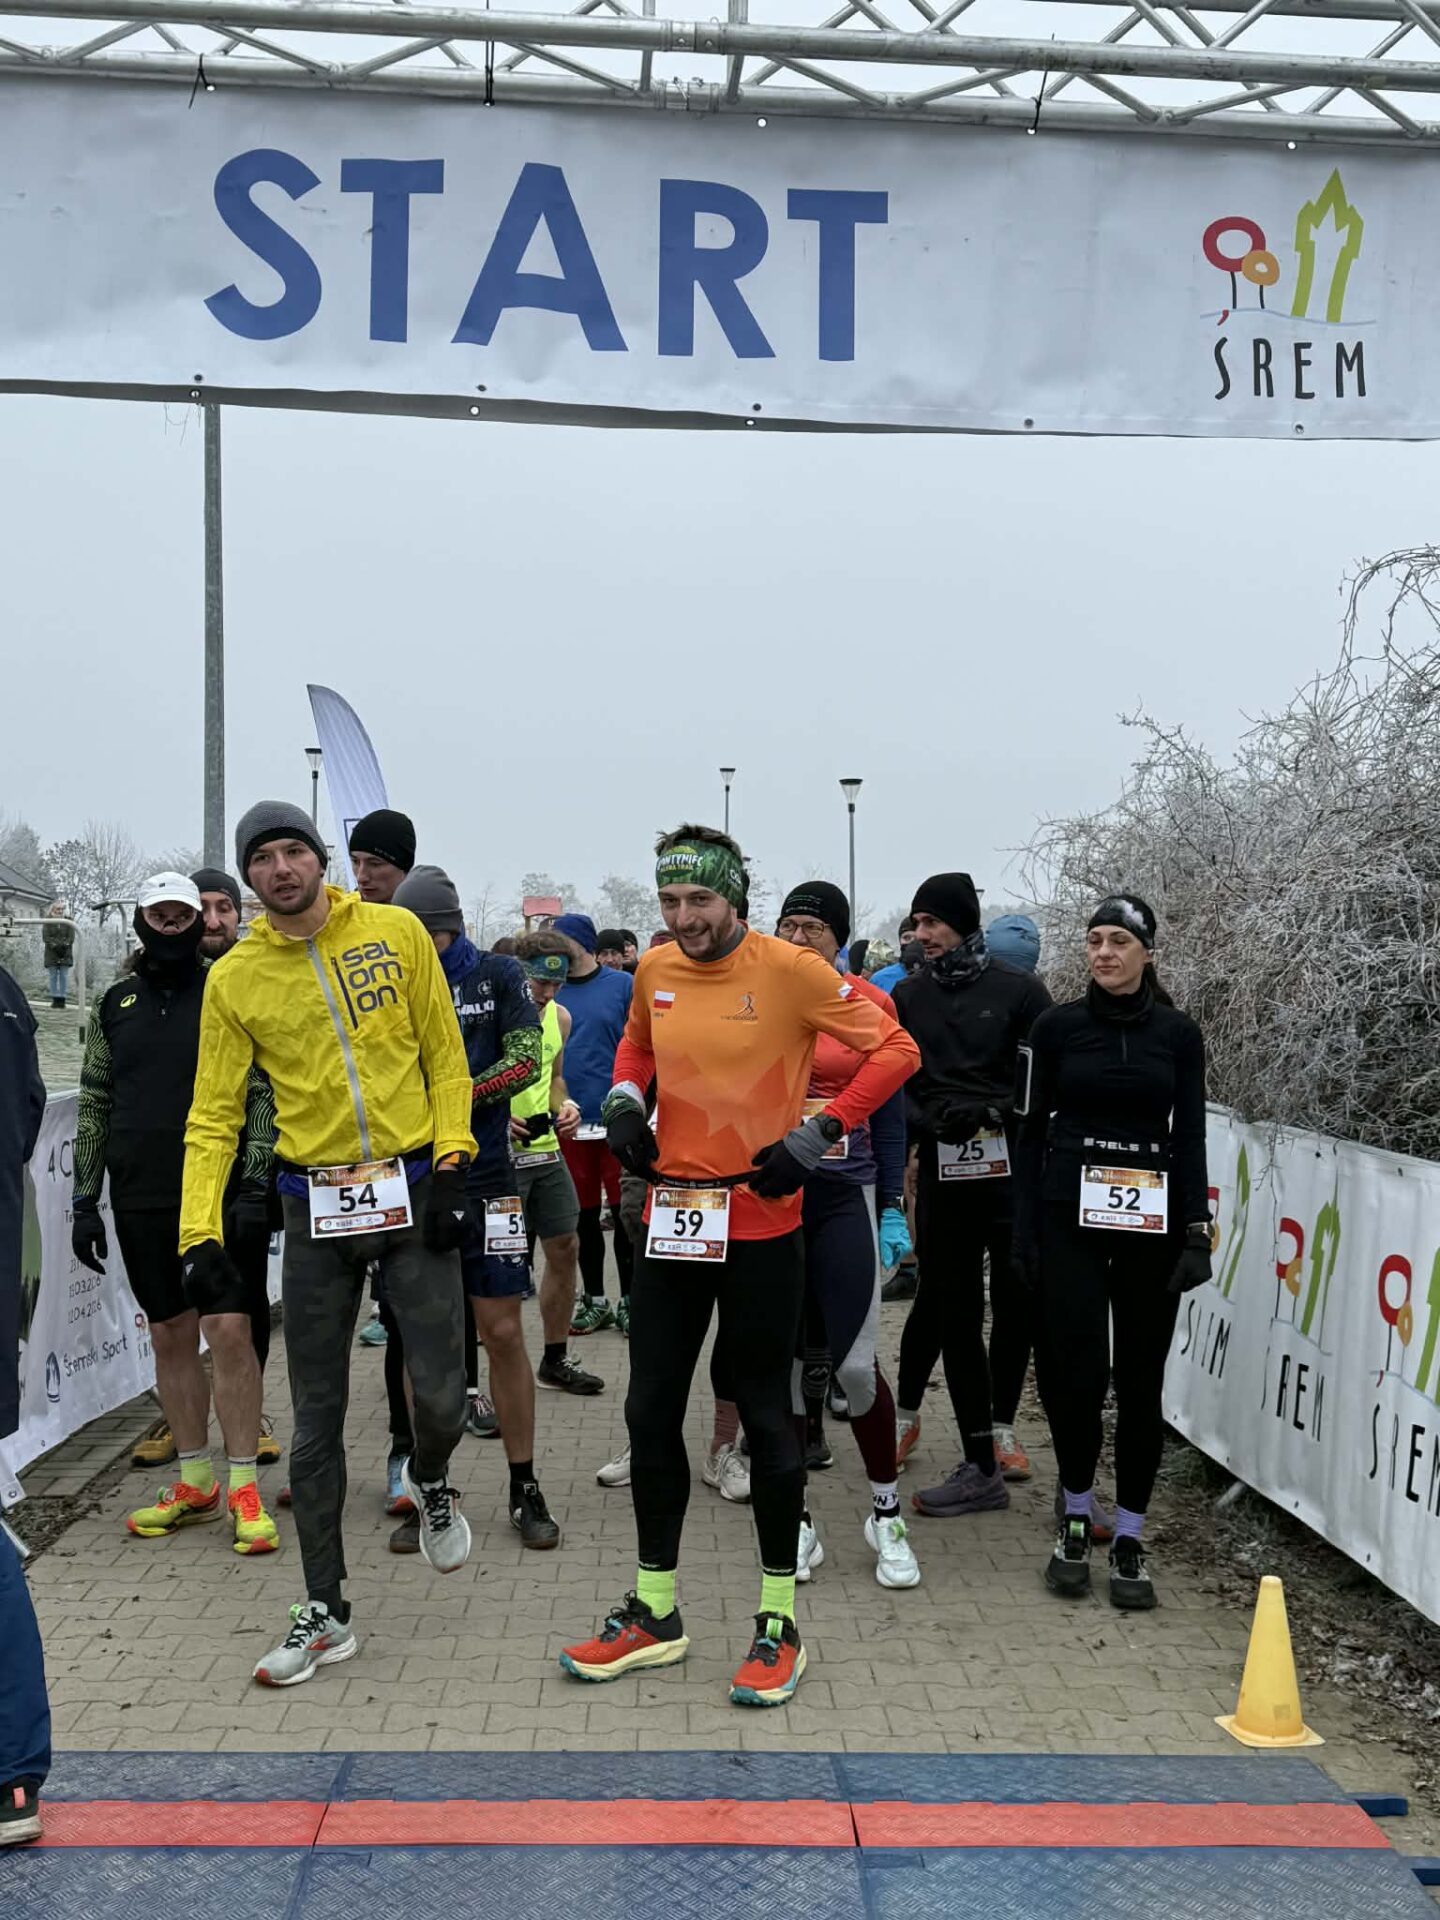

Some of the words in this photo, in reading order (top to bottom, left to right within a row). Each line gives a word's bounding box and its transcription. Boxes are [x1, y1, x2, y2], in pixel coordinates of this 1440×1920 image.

[203, 148, 890, 362] START
[1213, 309, 1367, 401] ŚREM
[956, 1140, 984, 1161] 25
[339, 1183, 378, 1212] 54
[1108, 1186, 1141, 1211] 52
[673, 1209, 704, 1237] 59
[102, 1333, 128, 1362] Sport
